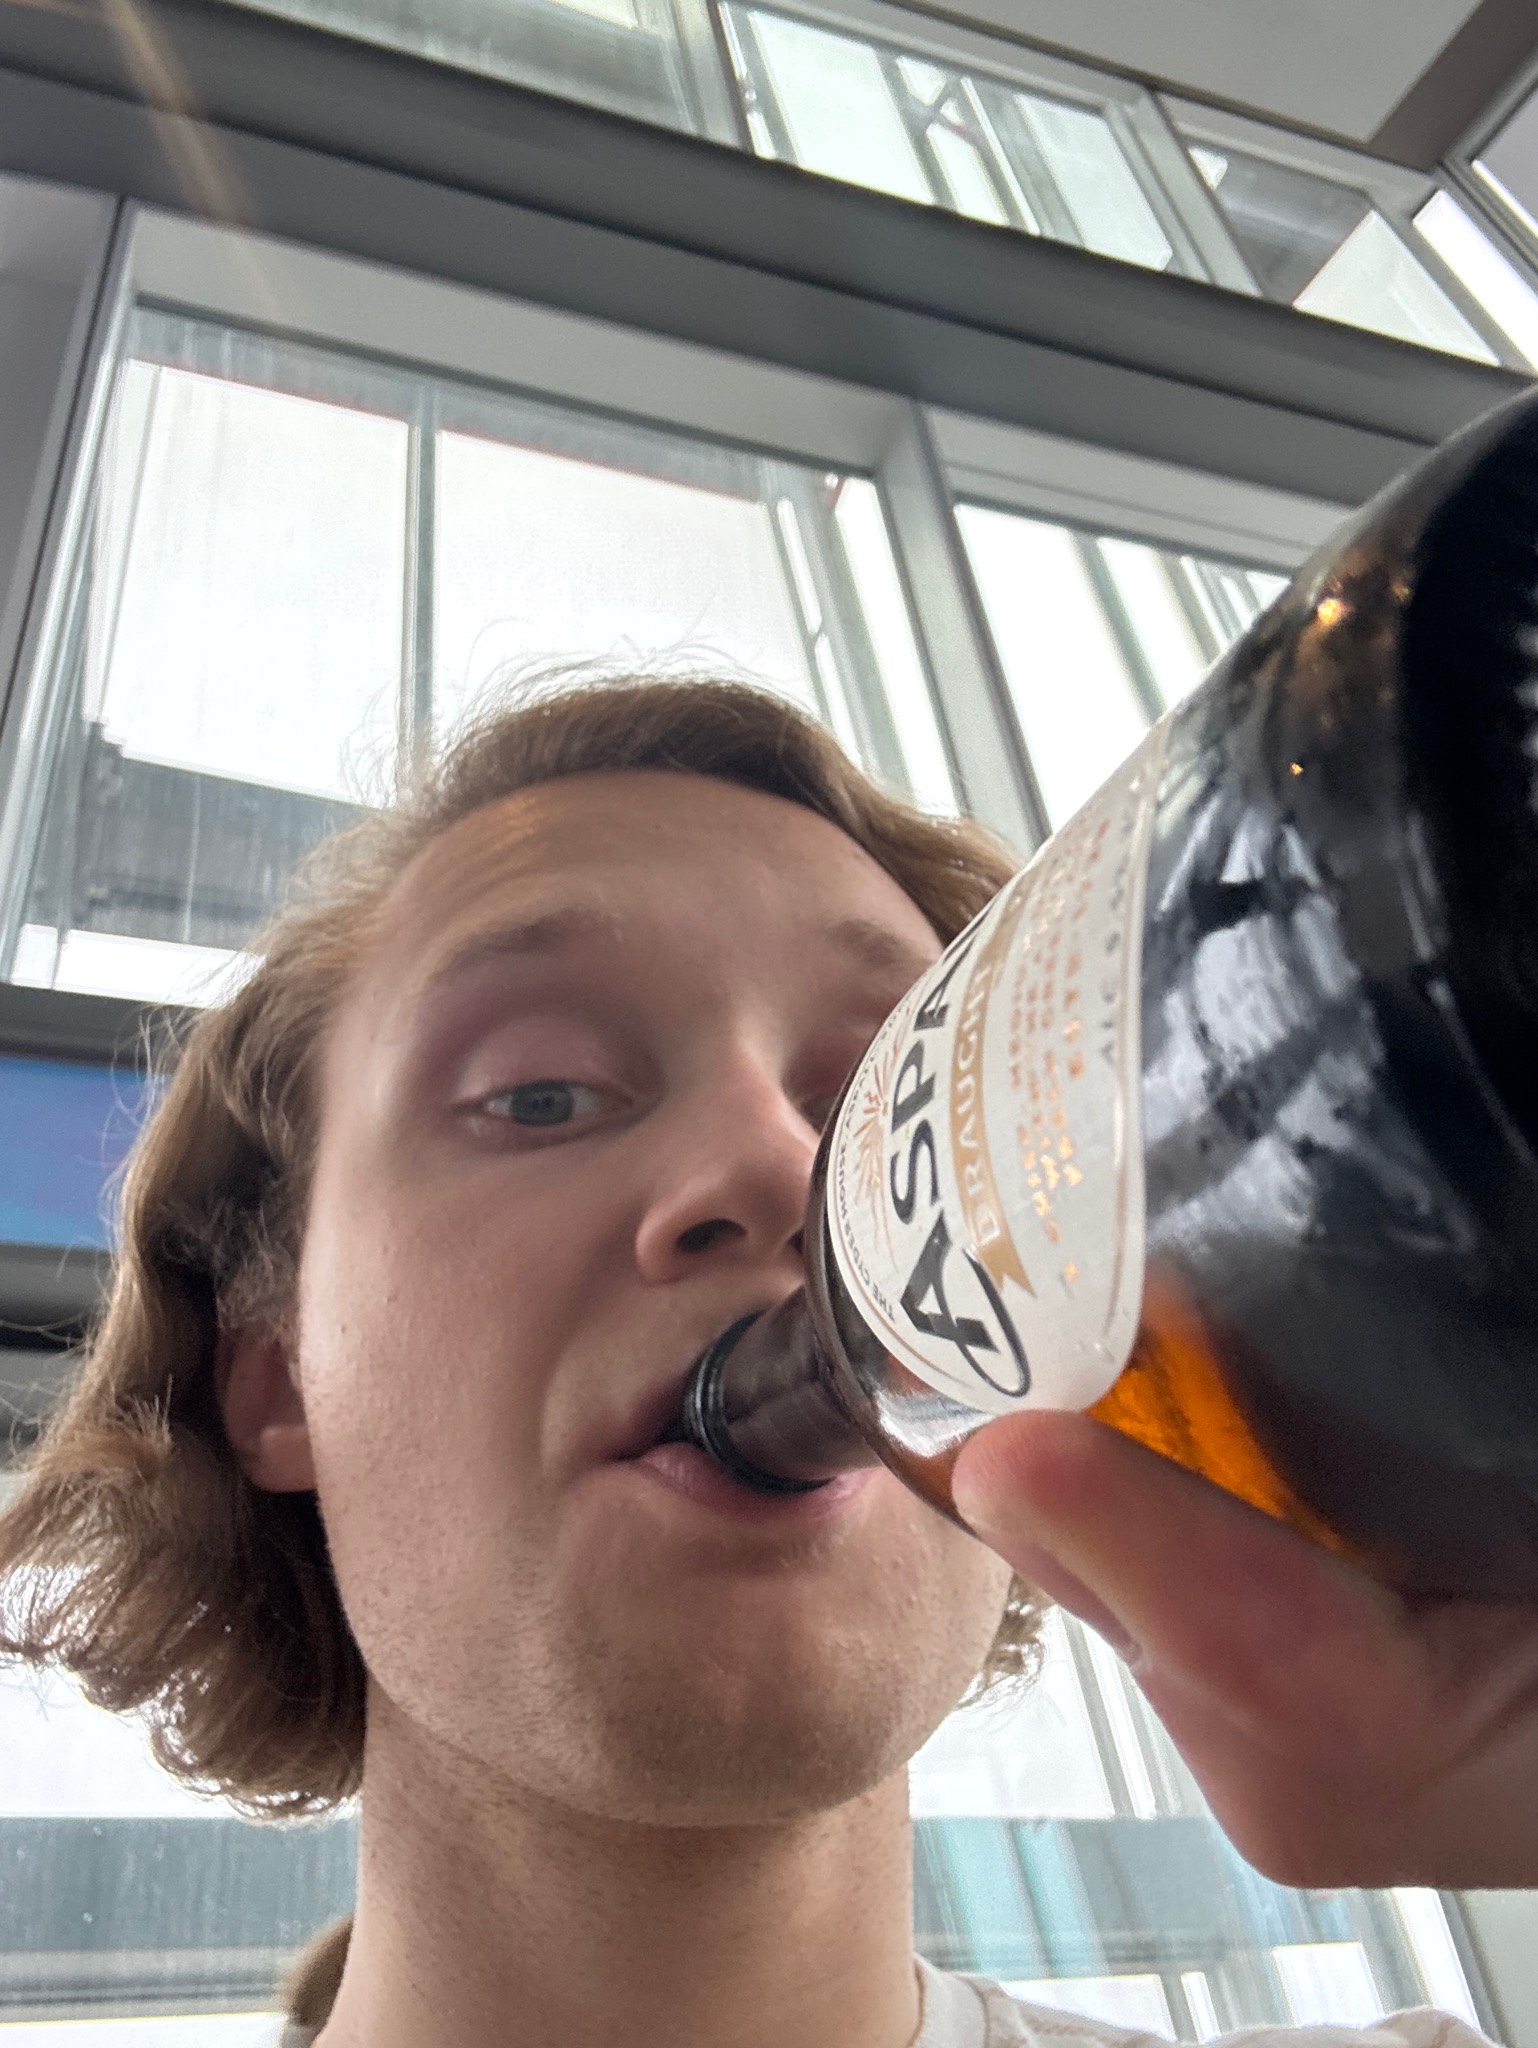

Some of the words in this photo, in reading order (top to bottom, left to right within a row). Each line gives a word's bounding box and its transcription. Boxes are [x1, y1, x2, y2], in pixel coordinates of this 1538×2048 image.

[956, 964, 1001, 1246] DRAUGHT
[845, 1222, 871, 1287] CYDER
[872, 1282, 895, 1322] THE
